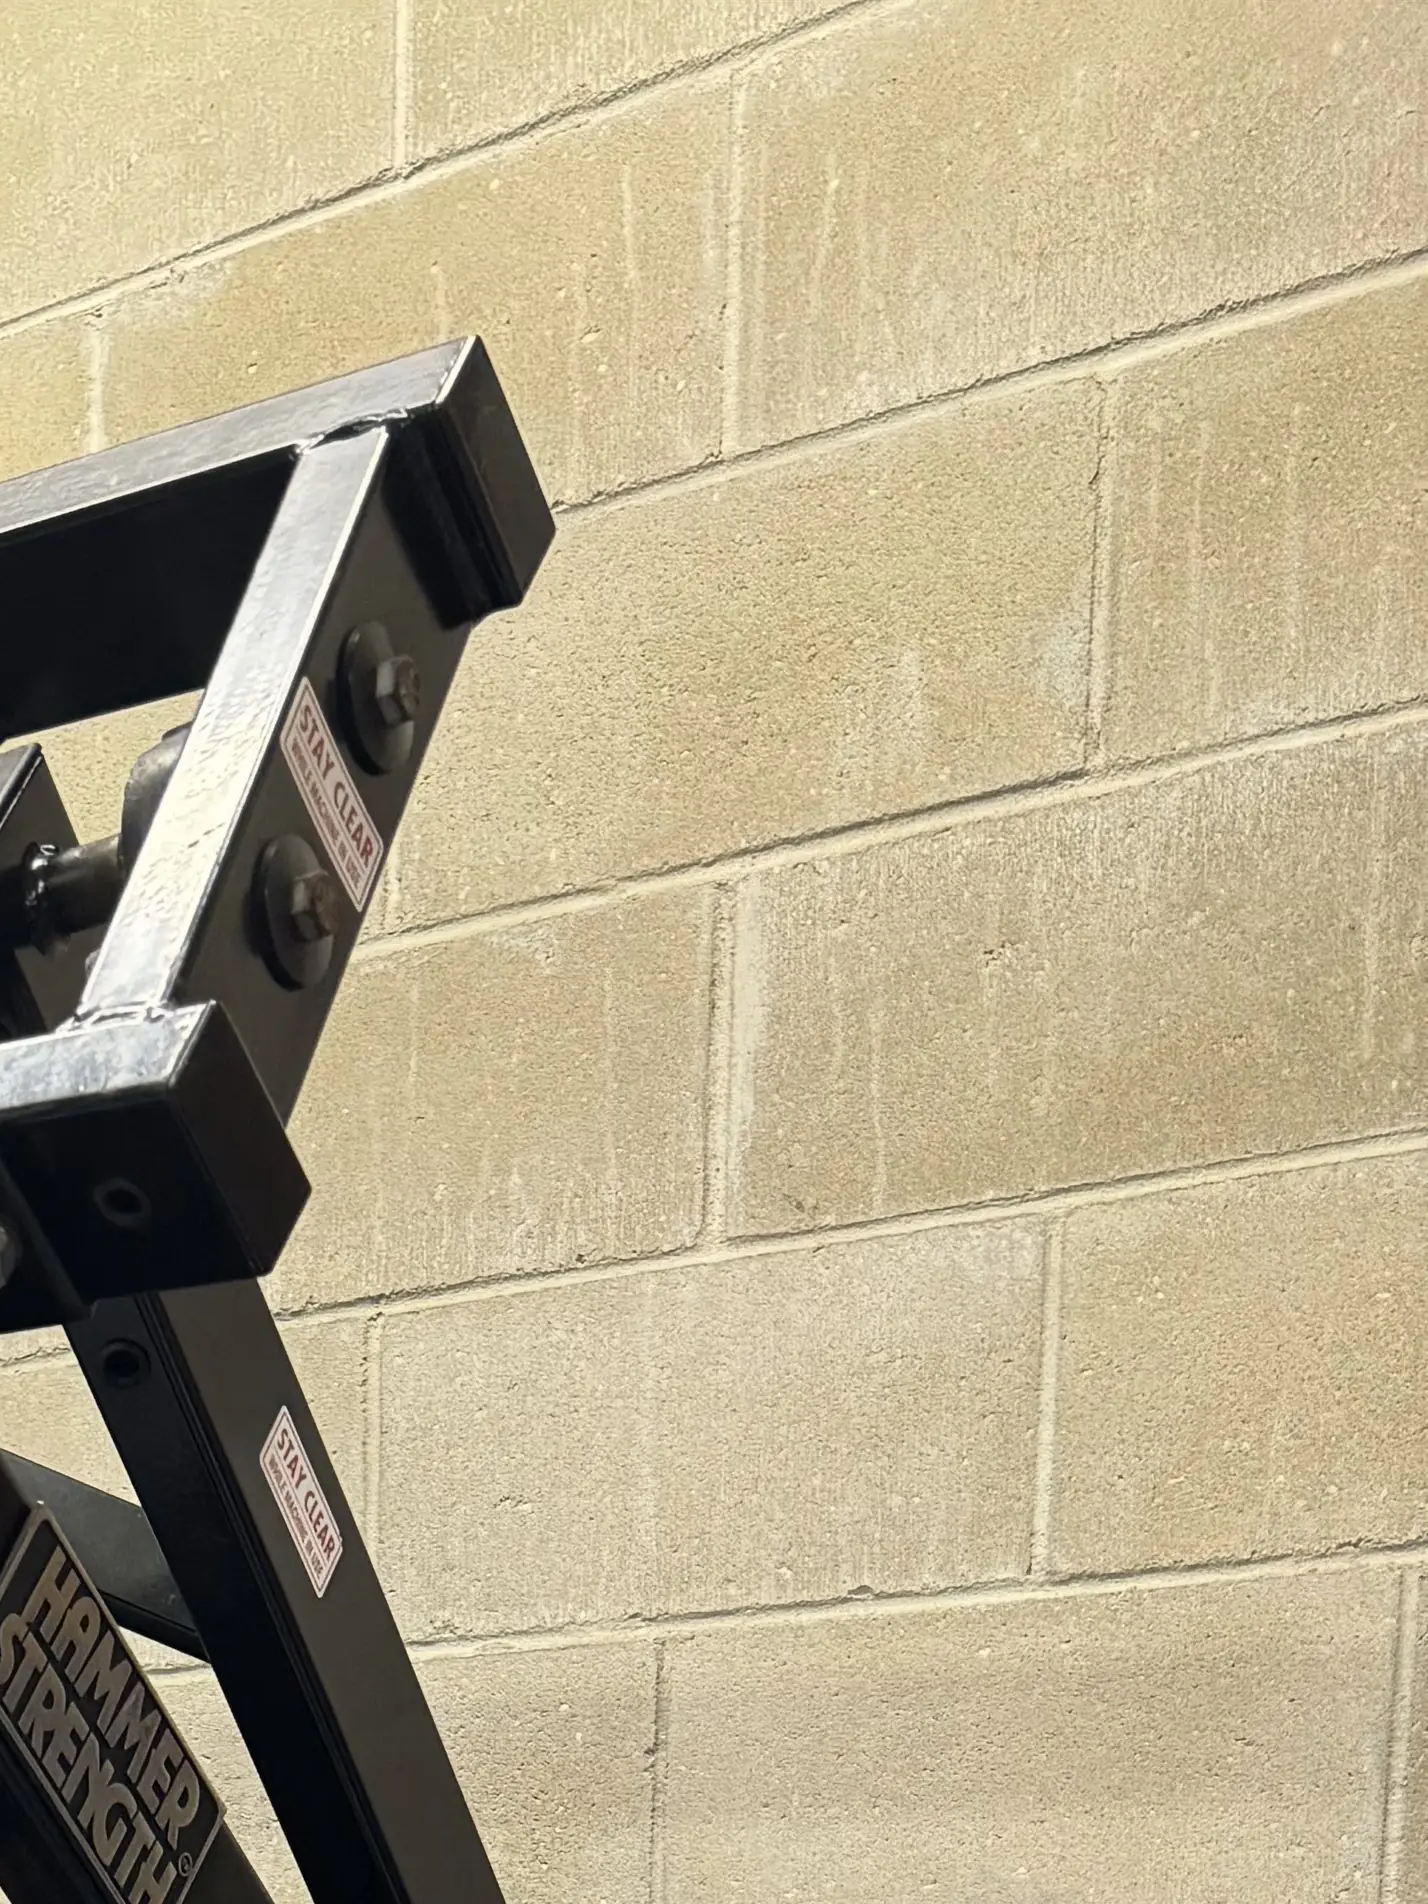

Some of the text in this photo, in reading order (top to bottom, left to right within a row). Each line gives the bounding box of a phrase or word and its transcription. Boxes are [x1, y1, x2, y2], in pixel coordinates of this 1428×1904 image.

[299, 704, 373, 867] STAY CLEAR
[276, 1428, 335, 1560] STAY CLEAR
[23, 1545, 200, 1850] HAMMER
